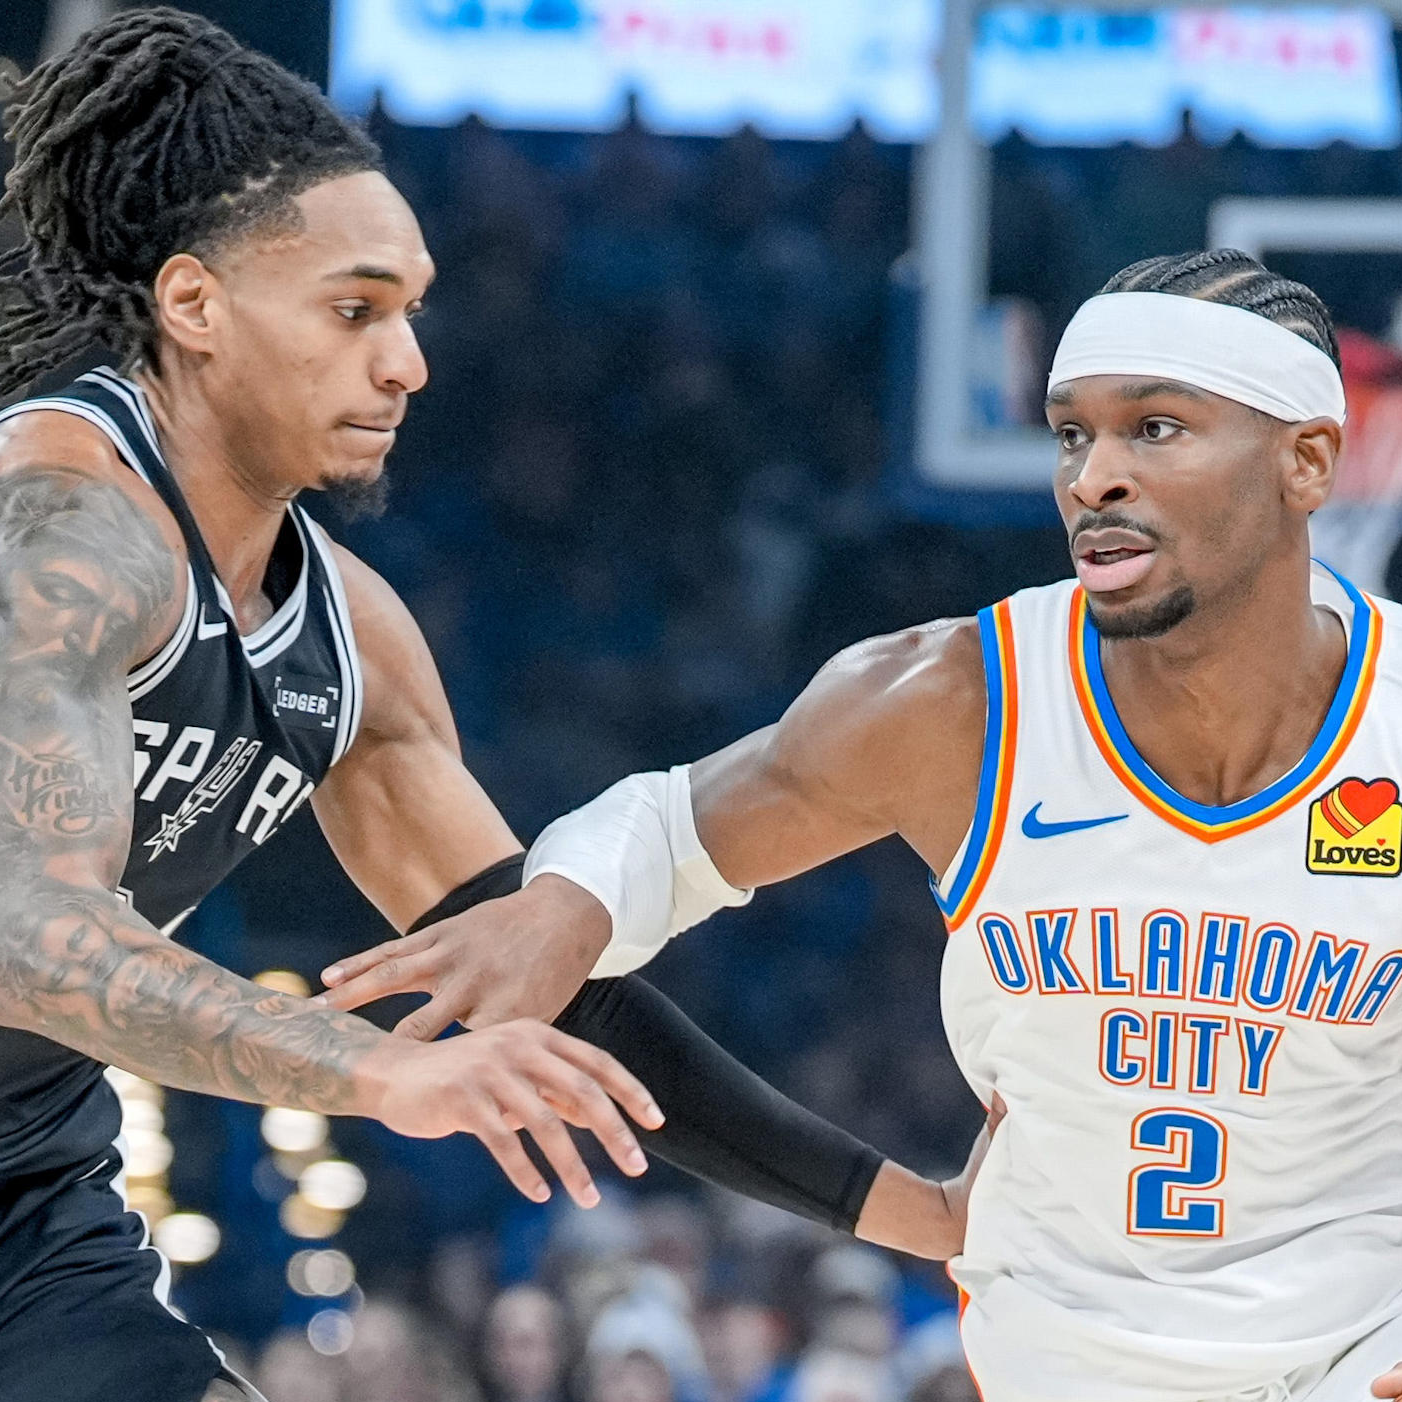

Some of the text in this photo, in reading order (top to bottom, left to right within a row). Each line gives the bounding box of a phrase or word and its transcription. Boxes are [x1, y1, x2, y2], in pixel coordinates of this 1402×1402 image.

[277, 688, 329, 715] LEDGER
[1100, 1009, 1285, 1096] CITY
[1127, 1108, 1228, 1237] 2
